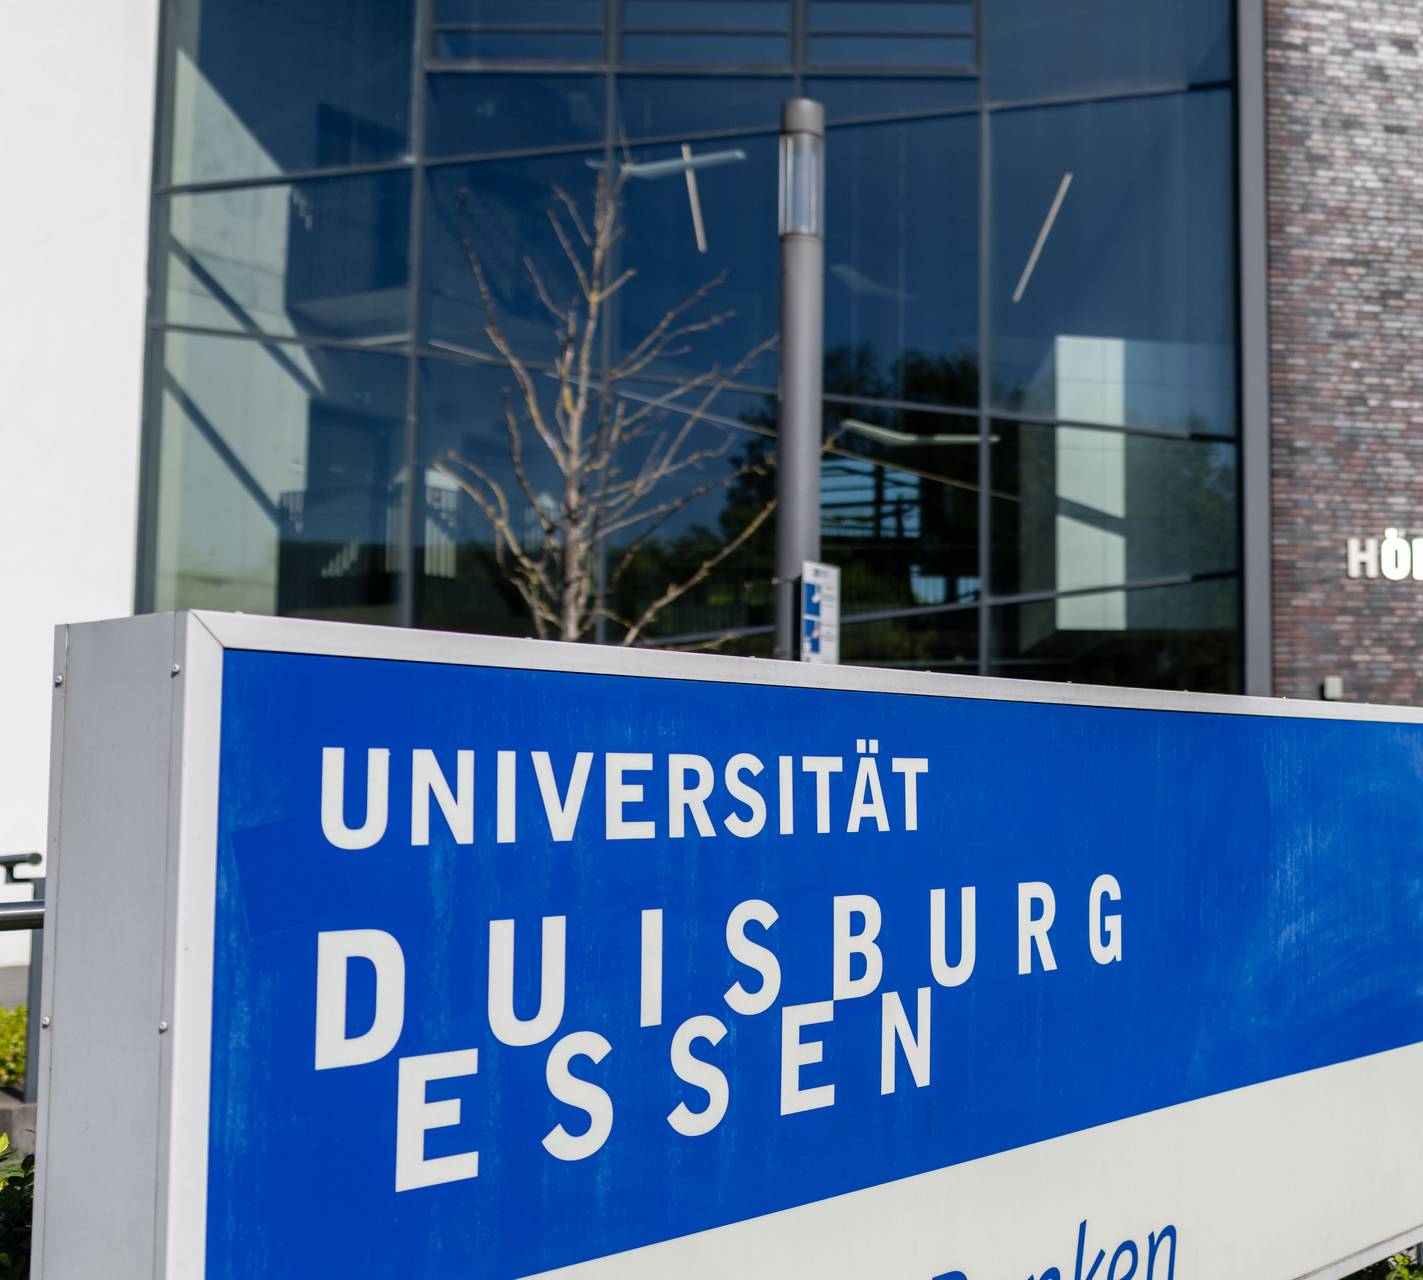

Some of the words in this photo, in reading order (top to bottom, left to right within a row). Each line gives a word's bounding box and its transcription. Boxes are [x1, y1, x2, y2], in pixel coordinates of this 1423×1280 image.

[321, 739, 929, 850] UNIVERSITÄT
[314, 874, 1123, 1071] DUISBURG
[395, 986, 932, 1193] ESSEN
